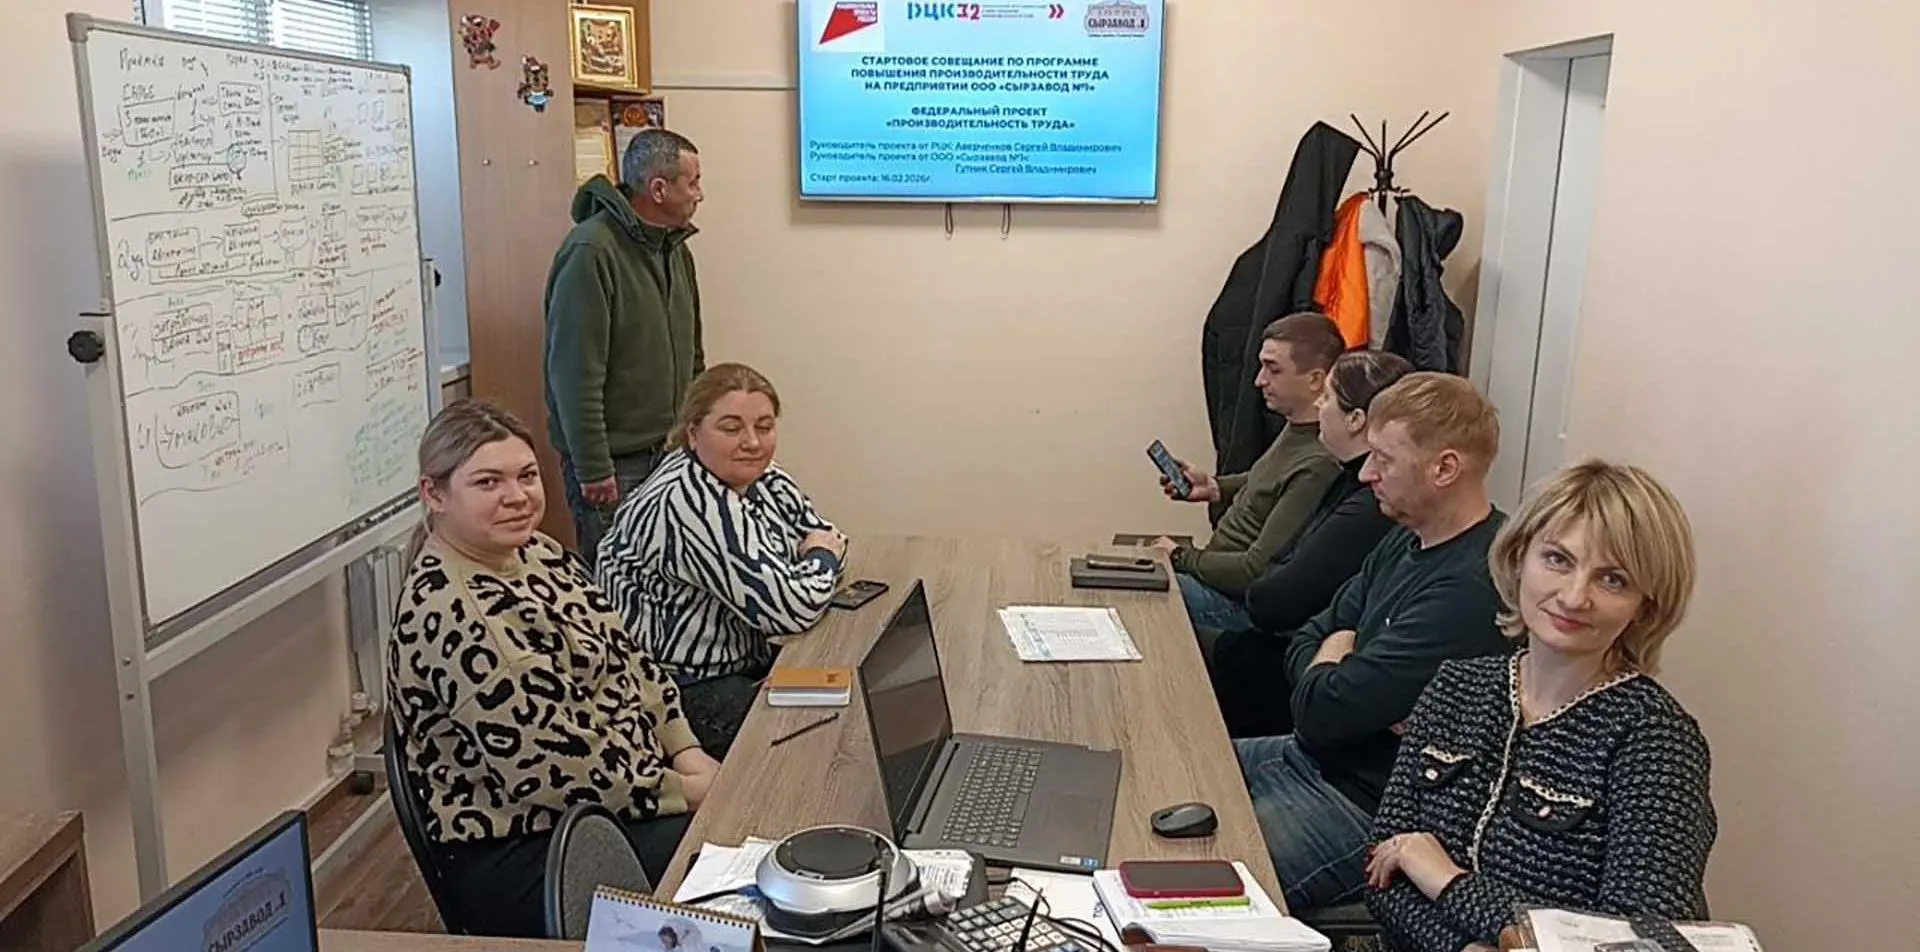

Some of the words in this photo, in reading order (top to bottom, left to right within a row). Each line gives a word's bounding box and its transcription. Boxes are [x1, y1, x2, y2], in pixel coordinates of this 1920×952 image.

[862, 56, 928, 66] СТАРТОВОЕ
[931, 57, 1004, 67] СОВЕЩАНИЕ
[1007, 57, 1024, 66] ПО
[1026, 57, 1099, 67] ПРОГРАММЕ
[851, 69, 926, 78] ПОВЫШЕНИЯ
[929, 69, 1067, 80] ПРОИЗВОДИТЕЛЬНОСТИ
[1071, 70, 1109, 80] ТРУДА
[865, 82, 880, 91] НА
[884, 82, 968, 92] ПРЕДПРИЯТИИ
[971, 82, 996, 91] ООО
[999, 82, 1070, 93] «СЫРЗАВОД
[911, 105, 1000, 116] ФЕДЕРАЛЬНЫЙ
[1003, 107, 1047, 117] ПРОЕКТ
[886, 119, 1028, 129] «ПРОИЗВОДИТЕЛЬНОСТЬ
[1032, 120, 1075, 130] ТРУДА»
[809, 140, 876, 151] Руководитель
[878, 141, 916, 151] проекта
[918, 142, 928, 150] от
[1014, 142, 1048, 152] Сергей
[1050, 142, 1122, 152] Владимирович
[809, 151, 876, 162] Руководитель
[878, 152, 916, 162] проекта
[918, 153, 928, 161] от
[930, 152, 953, 161] ООО
[989, 163, 1023, 174] Сергей
[1025, 164, 1097, 174] Владимирович
[810, 173, 836, 183] Старт
